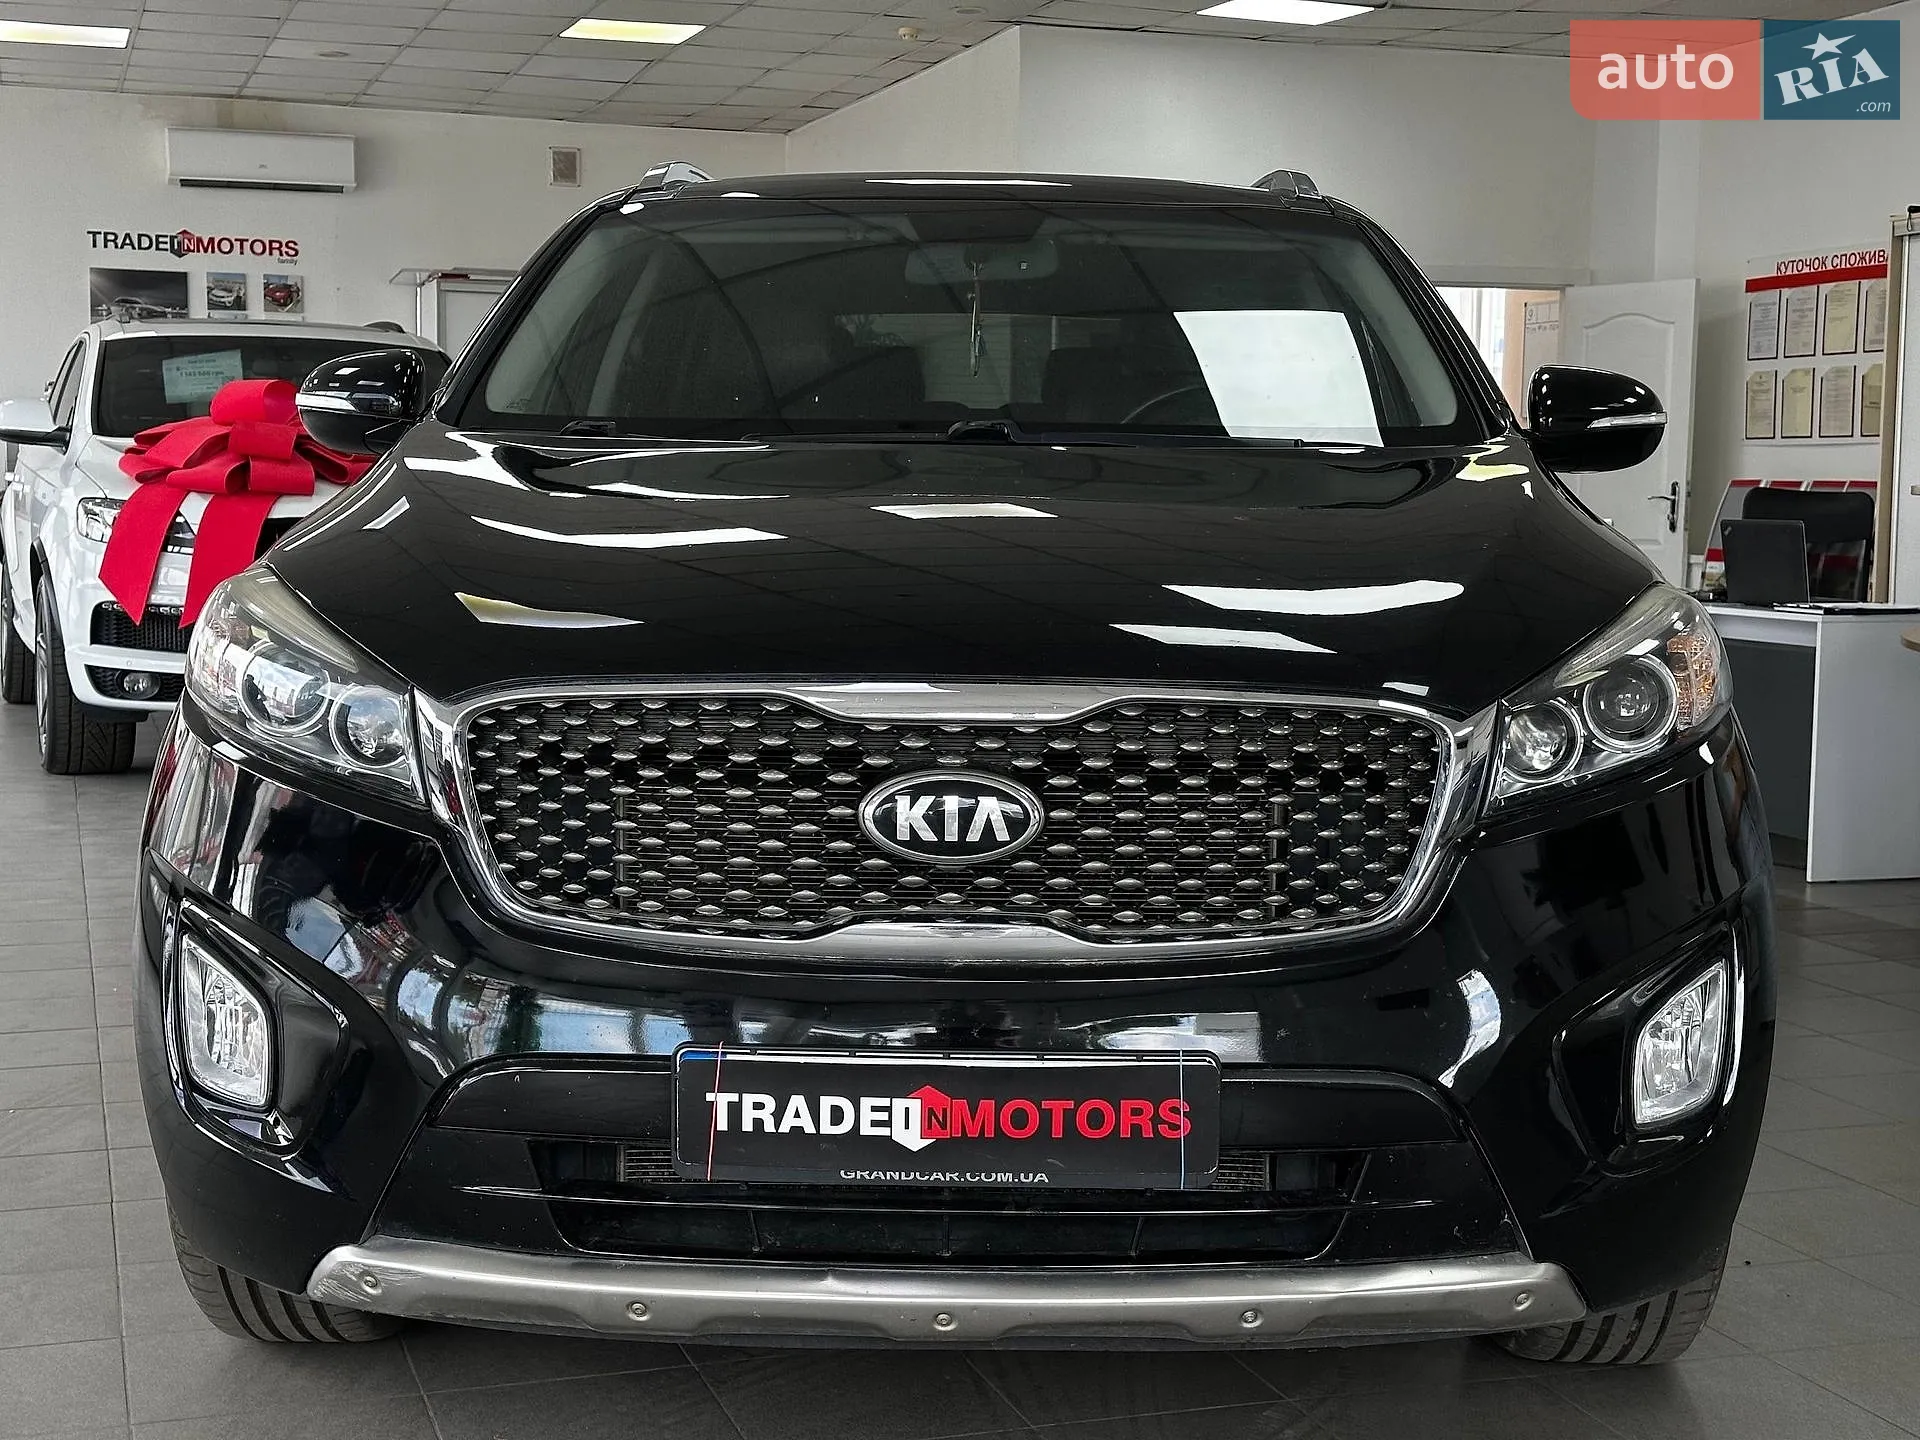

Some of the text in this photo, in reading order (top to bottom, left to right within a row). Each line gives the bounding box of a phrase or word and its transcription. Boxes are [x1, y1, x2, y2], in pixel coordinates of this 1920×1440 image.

[1776, 249, 1889, 275] КУТОЧОК СПОЖИВ
[895, 795, 1010, 842] KIA
